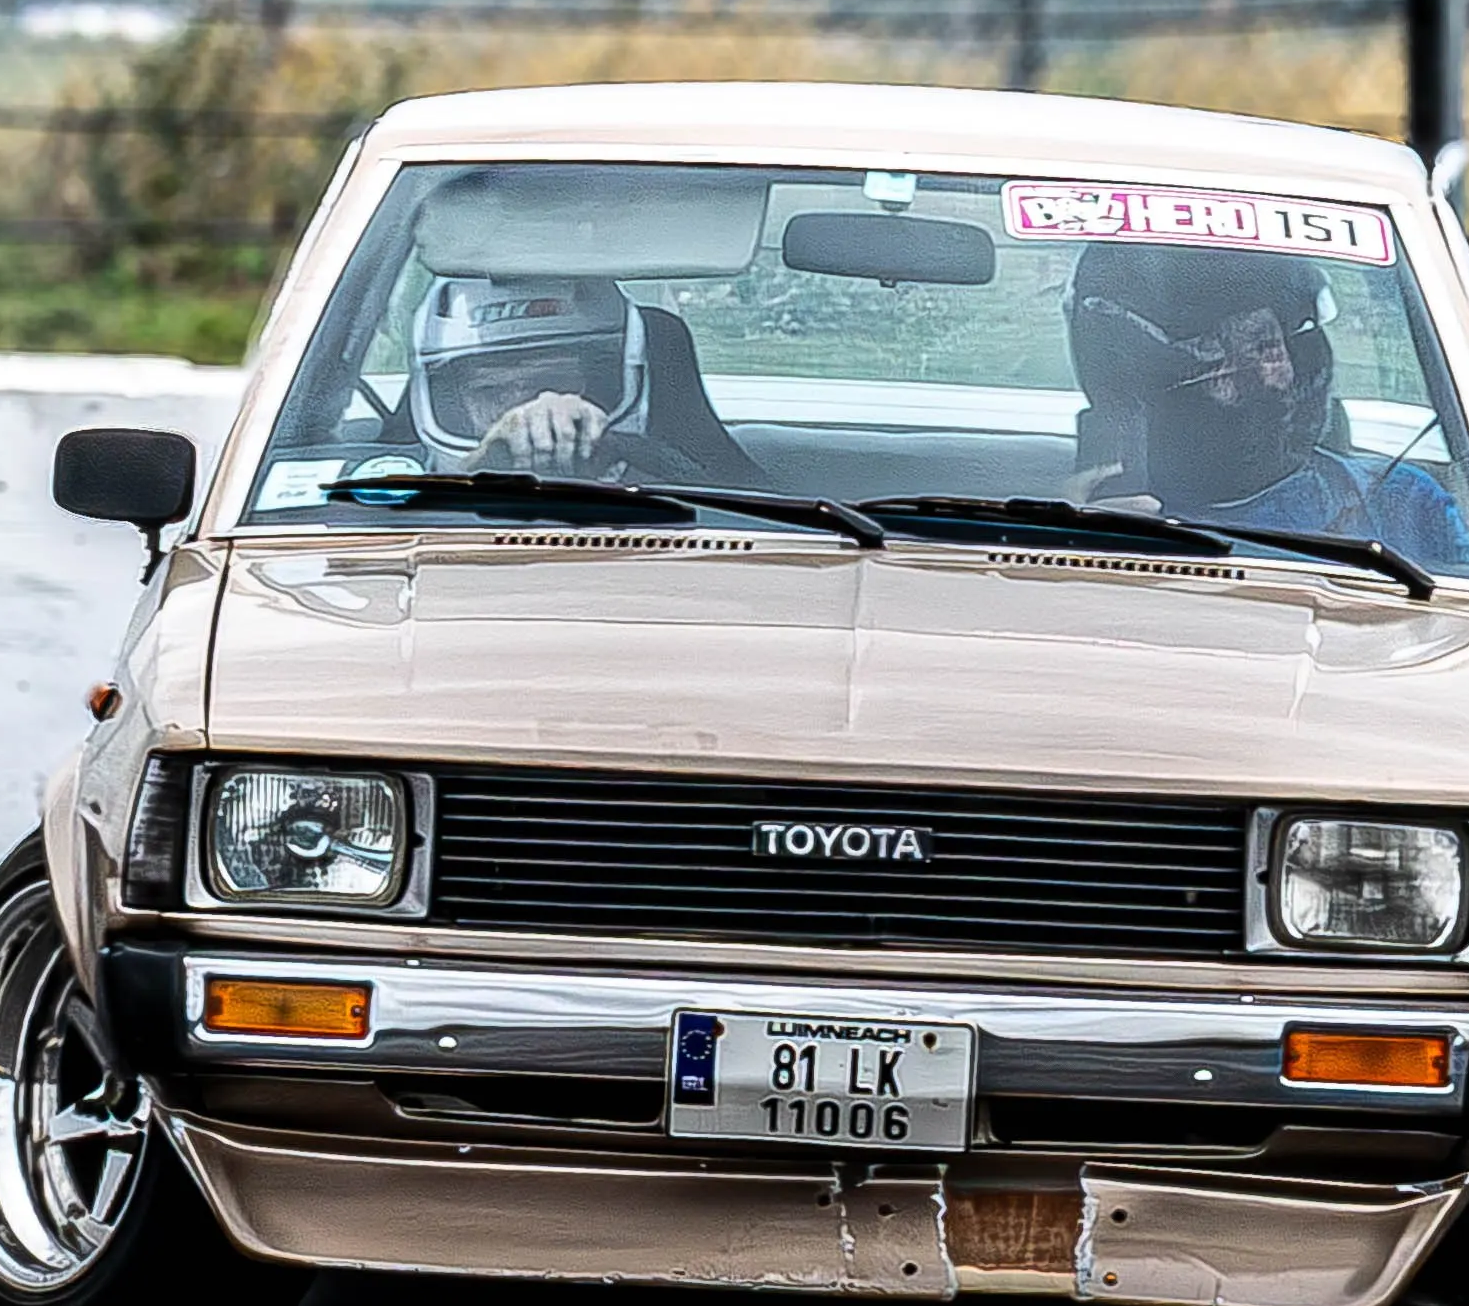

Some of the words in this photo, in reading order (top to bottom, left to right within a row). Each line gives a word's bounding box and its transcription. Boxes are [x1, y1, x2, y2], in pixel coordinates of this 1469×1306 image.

[1274, 210, 1359, 246] 151
[760, 824, 924, 859] TOYOTA
[767, 1021, 911, 1044] LUIMNEACH
[772, 1043, 819, 1092] 81
[848, 1047, 903, 1098] LK
[760, 1097, 909, 1141] 11006
